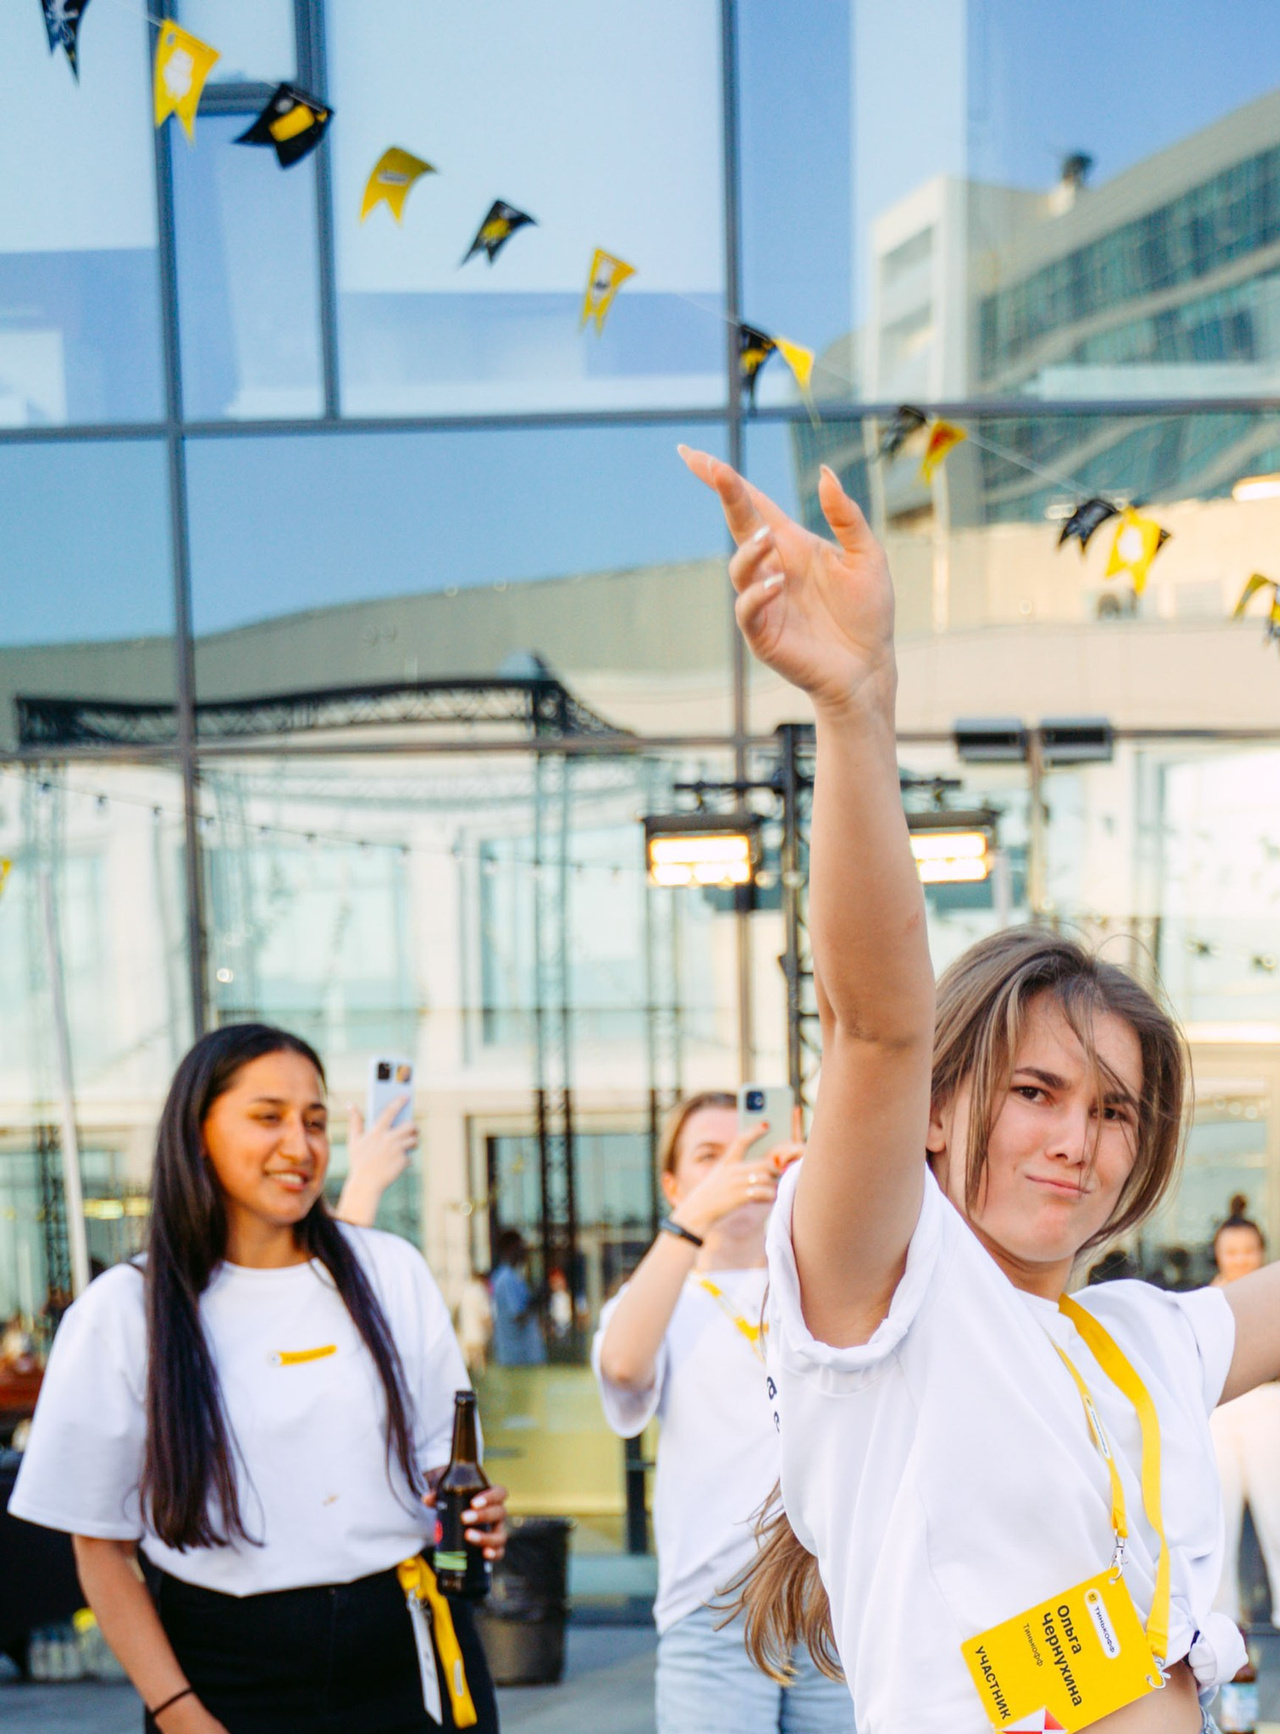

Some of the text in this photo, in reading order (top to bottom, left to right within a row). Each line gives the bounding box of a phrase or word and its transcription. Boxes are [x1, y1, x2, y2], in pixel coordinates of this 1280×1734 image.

[1023, 1623, 1044, 1667] Тинькофф
[1056, 1604, 1083, 1655] Ольга
[1094, 1605, 1116, 1653] ТИНЬКОФФ
[975, 1645, 1012, 1720] УЧАСТНИК
[1041, 1611, 1083, 1707] Чернухина
